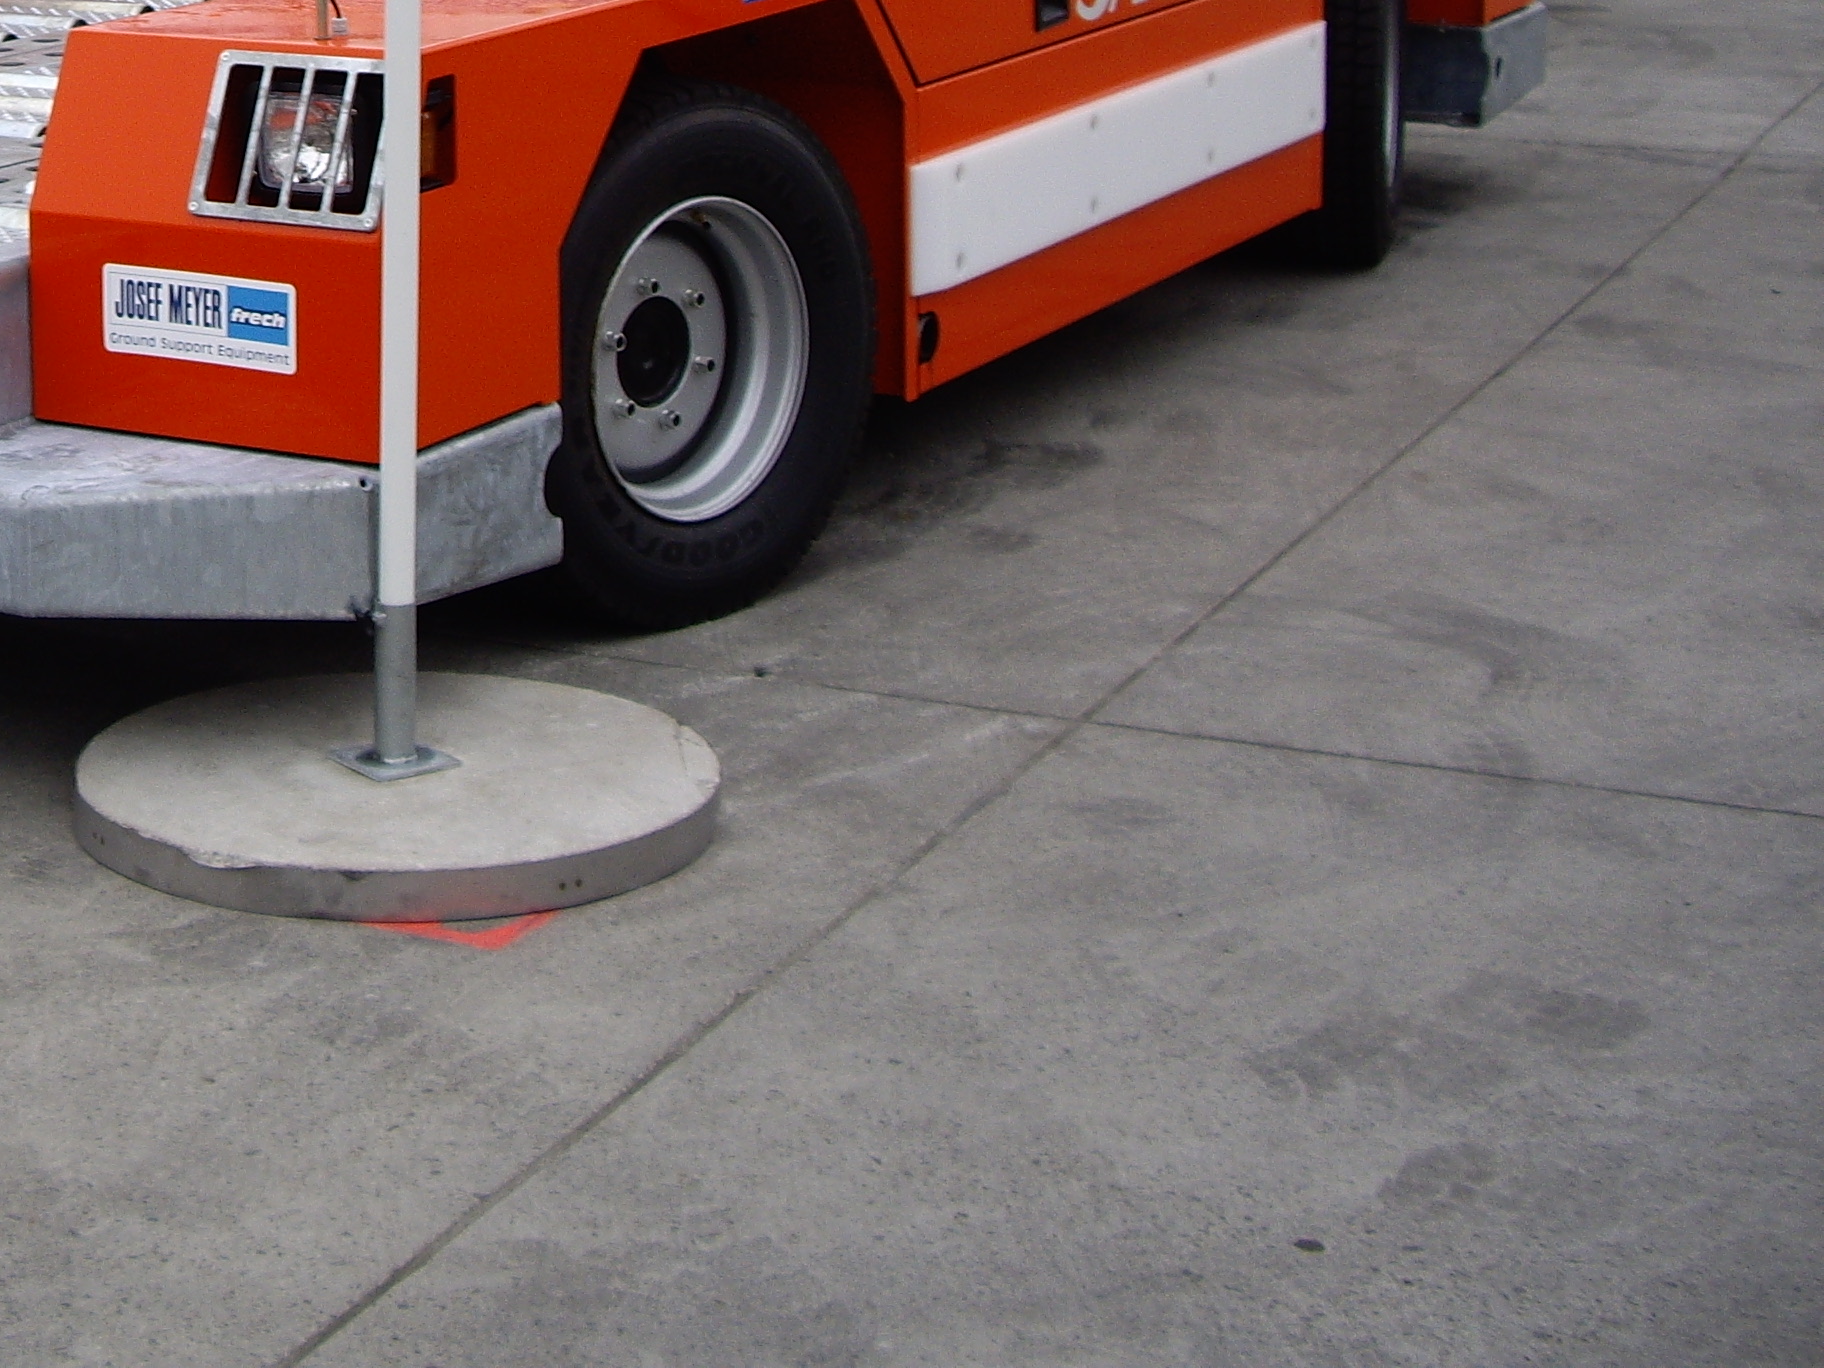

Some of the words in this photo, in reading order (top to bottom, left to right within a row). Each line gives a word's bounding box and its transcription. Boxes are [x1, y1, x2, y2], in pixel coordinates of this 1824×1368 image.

[115, 278, 164, 322] JOSEF
[168, 283, 223, 329] MEYER
[229, 305, 287, 329] frech
[109, 331, 157, 348] Ground
[160, 337, 214, 355] Support
[218, 344, 290, 366] Equipment
